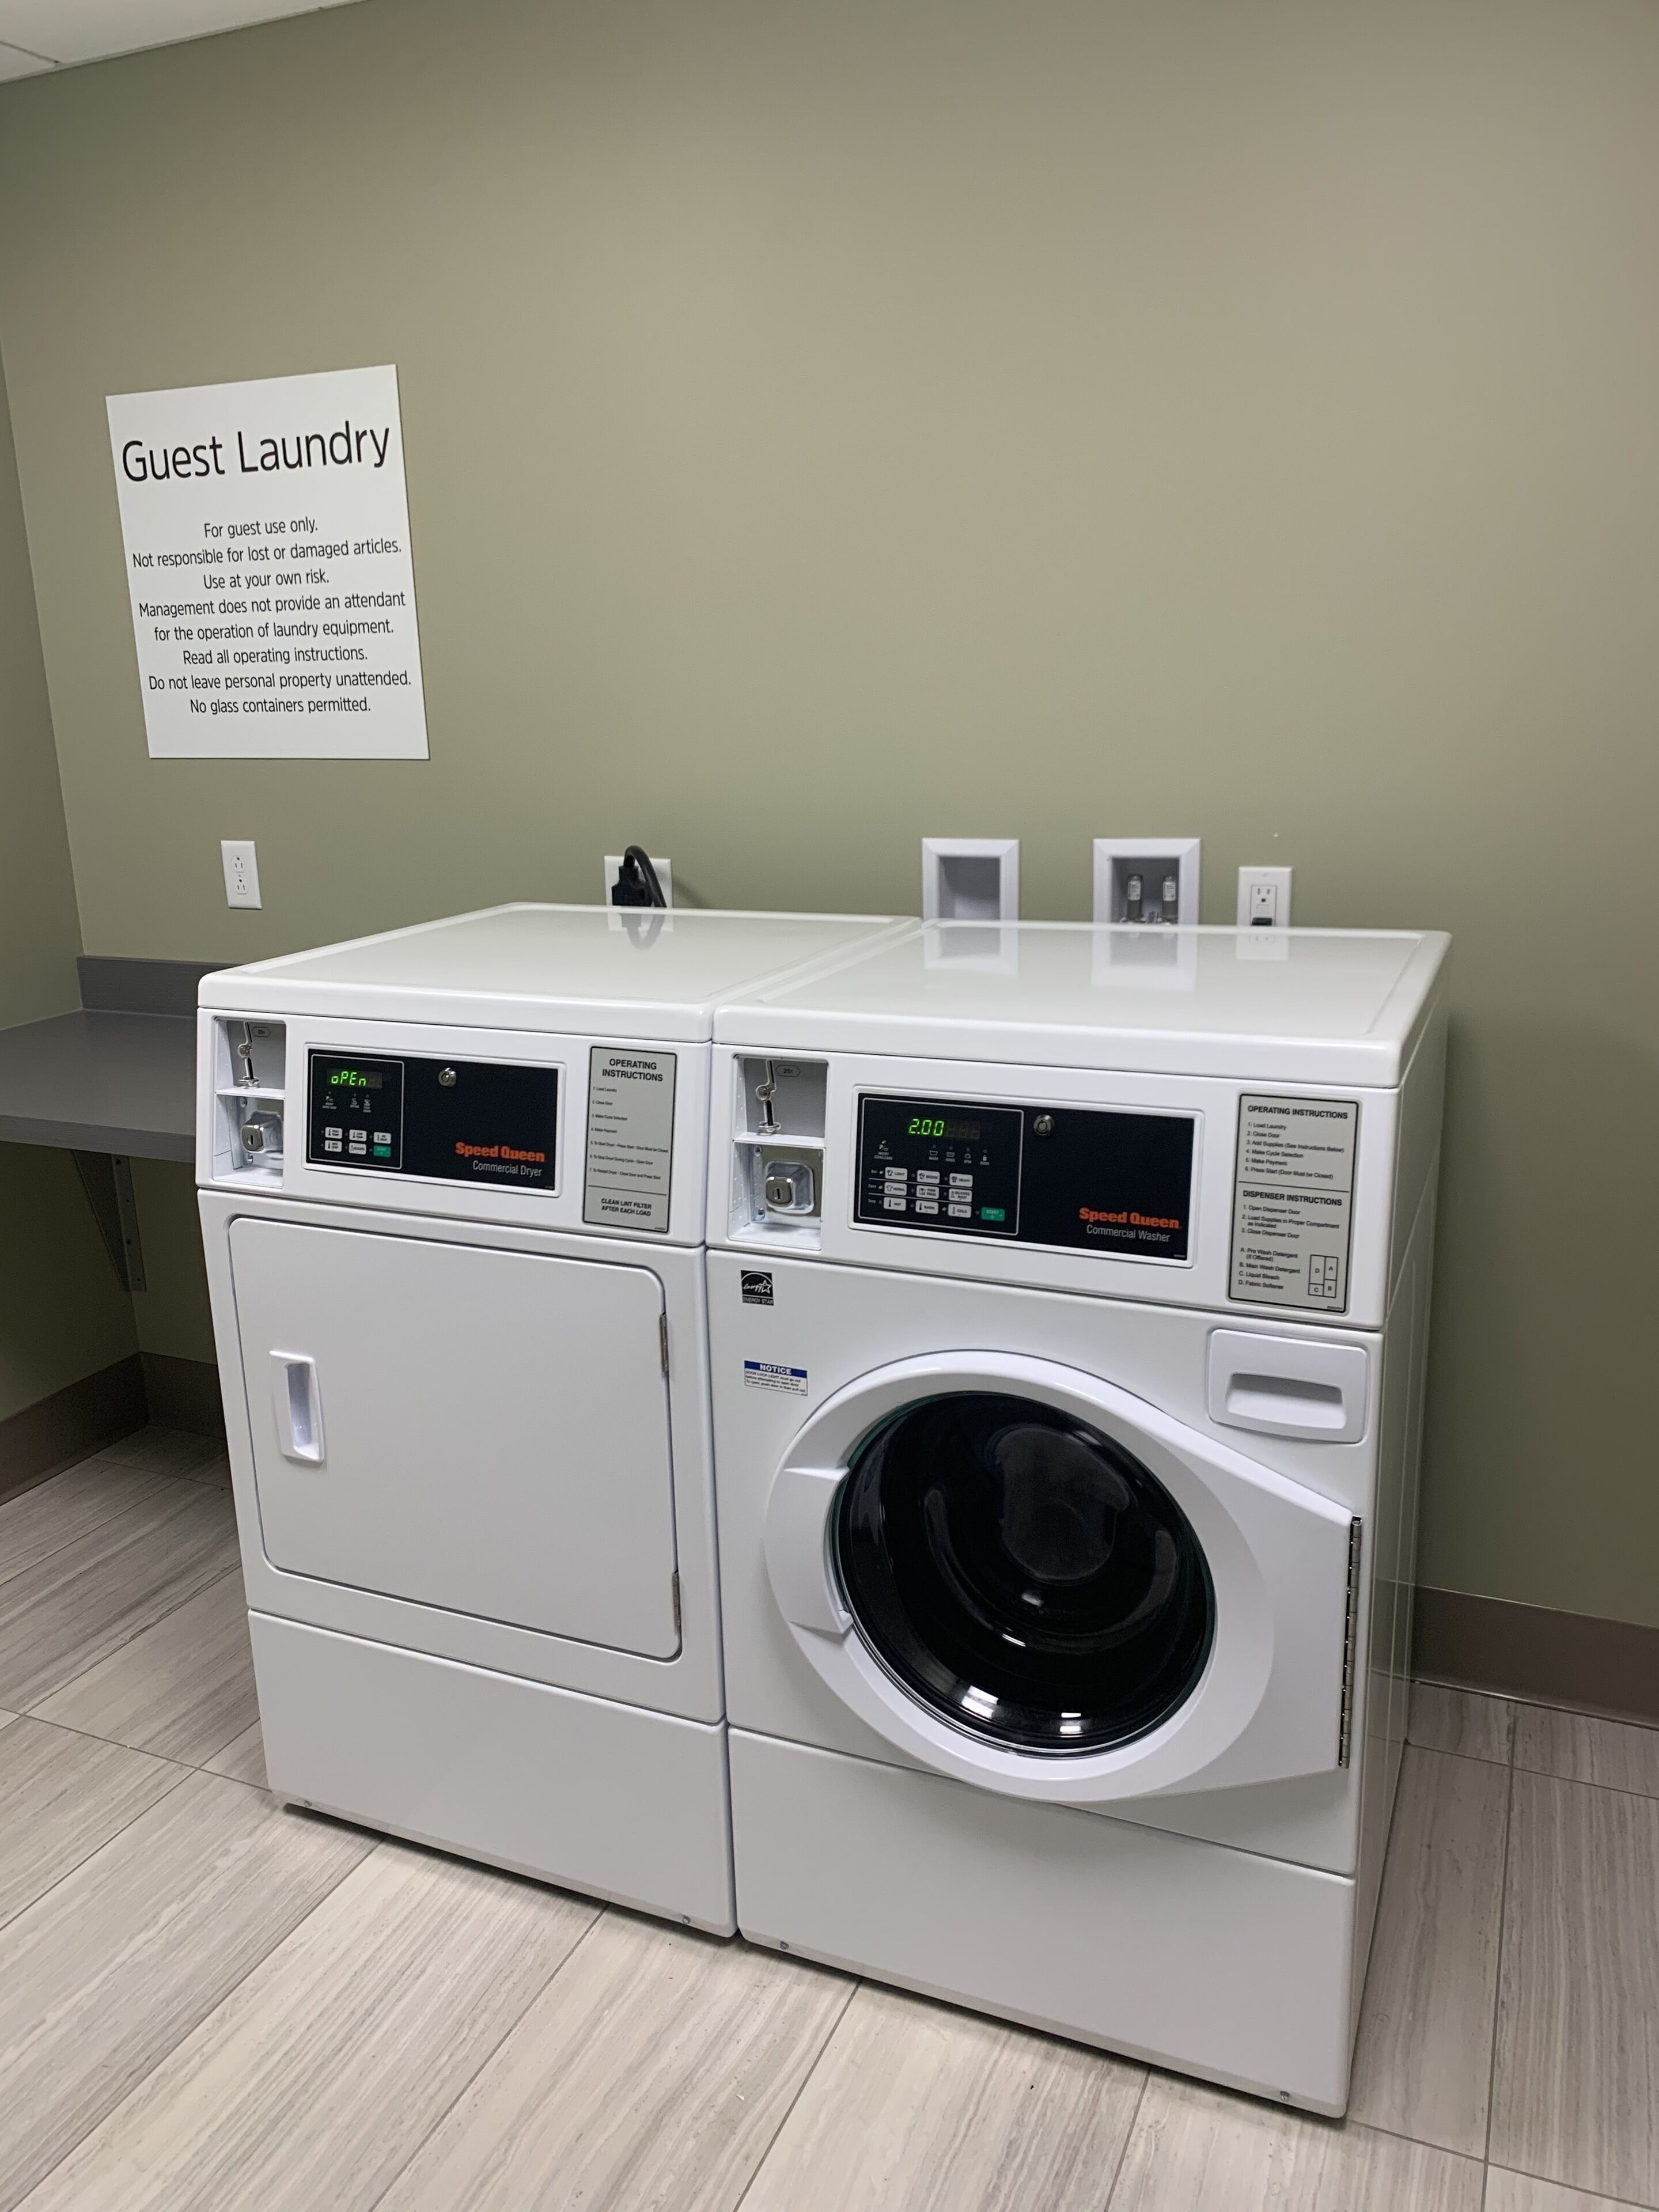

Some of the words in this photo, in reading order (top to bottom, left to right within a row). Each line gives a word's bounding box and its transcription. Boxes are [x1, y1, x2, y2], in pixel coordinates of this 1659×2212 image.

[123, 436, 225, 482] Guest
[238, 421, 389, 472] Laundry
[204, 523, 223, 537] For
[228, 521, 261, 539] guest
[265, 521, 285, 534] use
[290, 516, 317, 533] only.
[132, 553, 154, 567] Not
[157, 549, 223, 567] responsible
[227, 547, 243, 562] for
[248, 546, 270, 560] lost
[274, 548, 285, 559] or
[290, 540, 349, 558] damaged
[354, 538, 401, 554] articles.
[203, 574, 225, 589] Use
[230, 574, 241, 588] at
[245, 575, 271, 589] your
[276, 573, 301, 585] own
[306, 568, 329, 584] risk.
[139, 601, 215, 618] Management
[218, 599, 247, 613] does
[251, 598, 271, 612] not
[275, 595, 320, 613] provide
[325, 597, 339, 609] an
[344, 592, 405, 608] attendant
[154, 627, 169, 641] for
[174, 626, 192, 640] the
[198, 624, 253, 641] operation
[257, 622, 268, 637] of
[274, 621, 317, 637] laundry
[323, 619, 393, 637] equipment.
[183, 650, 213, 664] Read
[217, 649, 229, 664] all
[233, 648, 290, 665] operating
[294, 646, 367, 661] instructions.
[149, 676, 164, 689] Do
[169, 676, 188, 689] not
[191, 675, 220, 688] leave
[225, 673, 275, 690] personal
[279, 673, 331, 688] property
[336, 670, 410, 685] unattended.
[190, 699, 206, 713] No
[210, 699, 238, 714] glass
[243, 698, 304, 712] containers
[308, 696, 370, 713] permitted.
[609, 1058, 657, 1070] OPERATING
[602, 1069, 663, 1082] INSTRUCTIONS
[1248, 1105, 1290, 1115] OPERATING
[1292, 1109, 1347, 1119] INSTRUCTIONS
[909, 1119, 945, 1136] 2.00
[456, 1142, 499, 1157] Speed
[501, 1146, 545, 1162] Queen
[472, 1160, 518, 1174] Commercial
[520, 1165, 542, 1177] Dryer
[1243, 1190, 1285, 1200] DISPENSER
[1286, 1195, 1342, 1206] INSTRUCTIONS
[1079, 1207, 1127, 1223] Speed
[1130, 1213, 1180, 1229] Queen
[1086, 1224, 1136, 1238] Commercial
[1138, 1230, 1171, 1242] Washer
[759, 1364, 791, 1375] NOTICE
